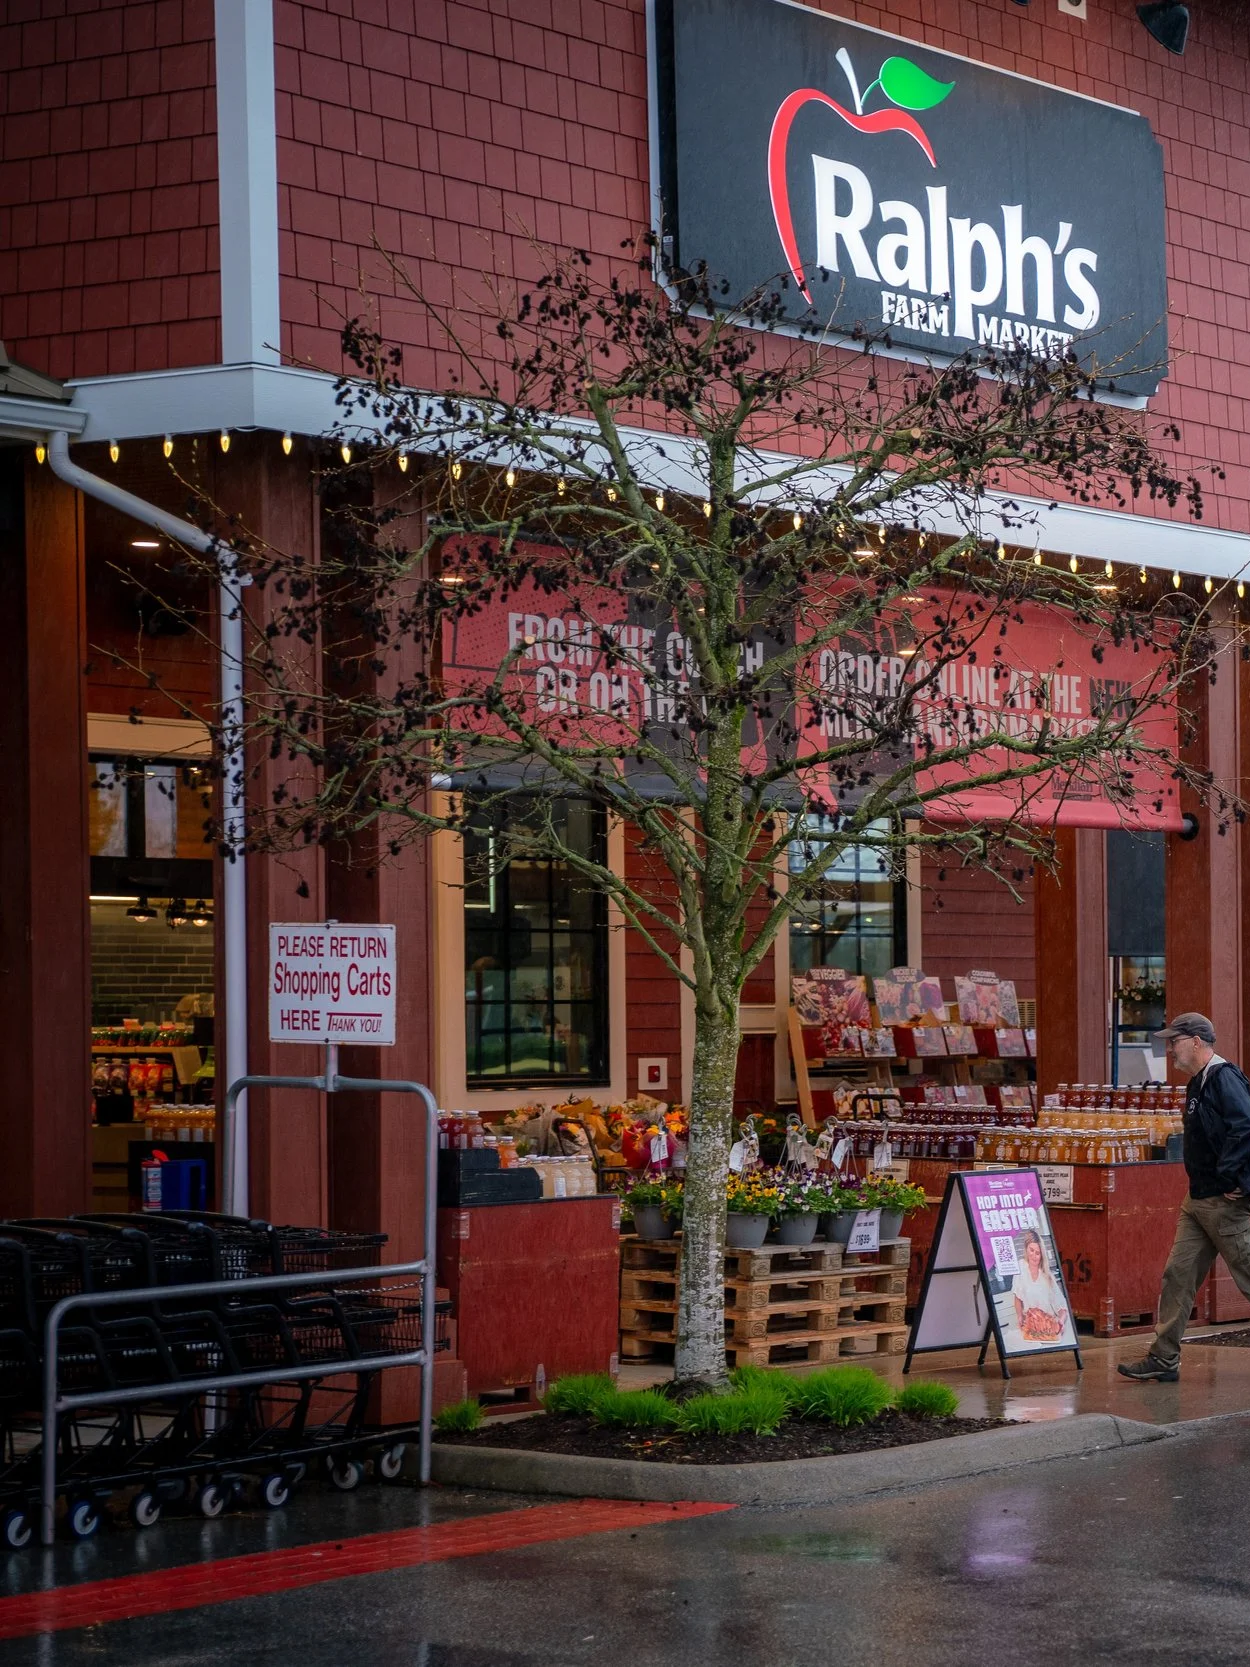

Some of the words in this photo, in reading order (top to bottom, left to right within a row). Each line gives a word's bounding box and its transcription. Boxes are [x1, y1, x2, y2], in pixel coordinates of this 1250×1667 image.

[811, 153, 1100, 341] Ralph's
[880, 290, 950, 338] FARM
[977, 313, 1074, 362] MARKET
[508, 612, 592, 666] FROM
[603, 623, 657, 673] THE
[536, 666, 578, 714] OR
[589, 672, 629, 719] ON
[820, 649, 905, 697] ORDER
[914, 660, 999, 707] ONLINE
[1007, 671, 1034, 710] AT
[1039, 673, 1082, 714] THE
[278, 936, 324, 957] PLEASE
[330, 936, 387, 958] RETURN
[274, 962, 340, 1002] Shopping
[347, 963, 391, 996] Carts
[280, 1009, 320, 1031] HERE
[326, 1012, 356, 1032] THANK
[360, 1019, 381, 1033] YOU!
[976, 1195, 998, 1209] HOP
[999, 1194, 1023, 1208] INTO
[980, 1207, 1040, 1232] EASTER
